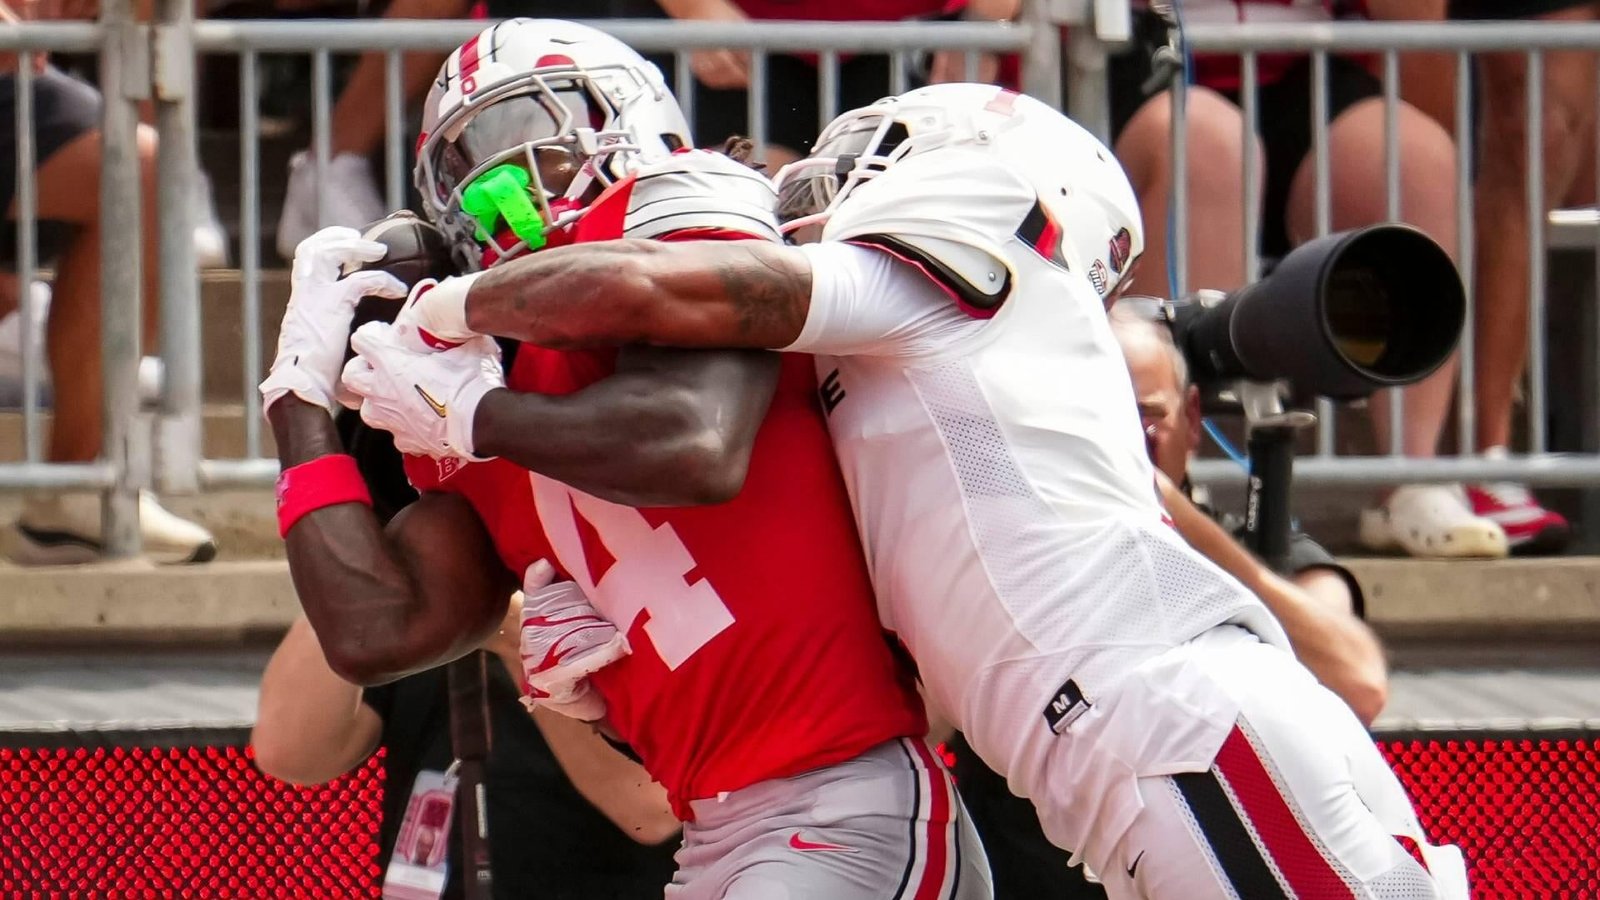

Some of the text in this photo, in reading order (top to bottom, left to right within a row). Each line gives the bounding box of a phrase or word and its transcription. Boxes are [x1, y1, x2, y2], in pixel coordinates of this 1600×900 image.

[820, 367, 846, 417] E
[529, 470, 736, 672] 4
[1052, 693, 1070, 714] M
